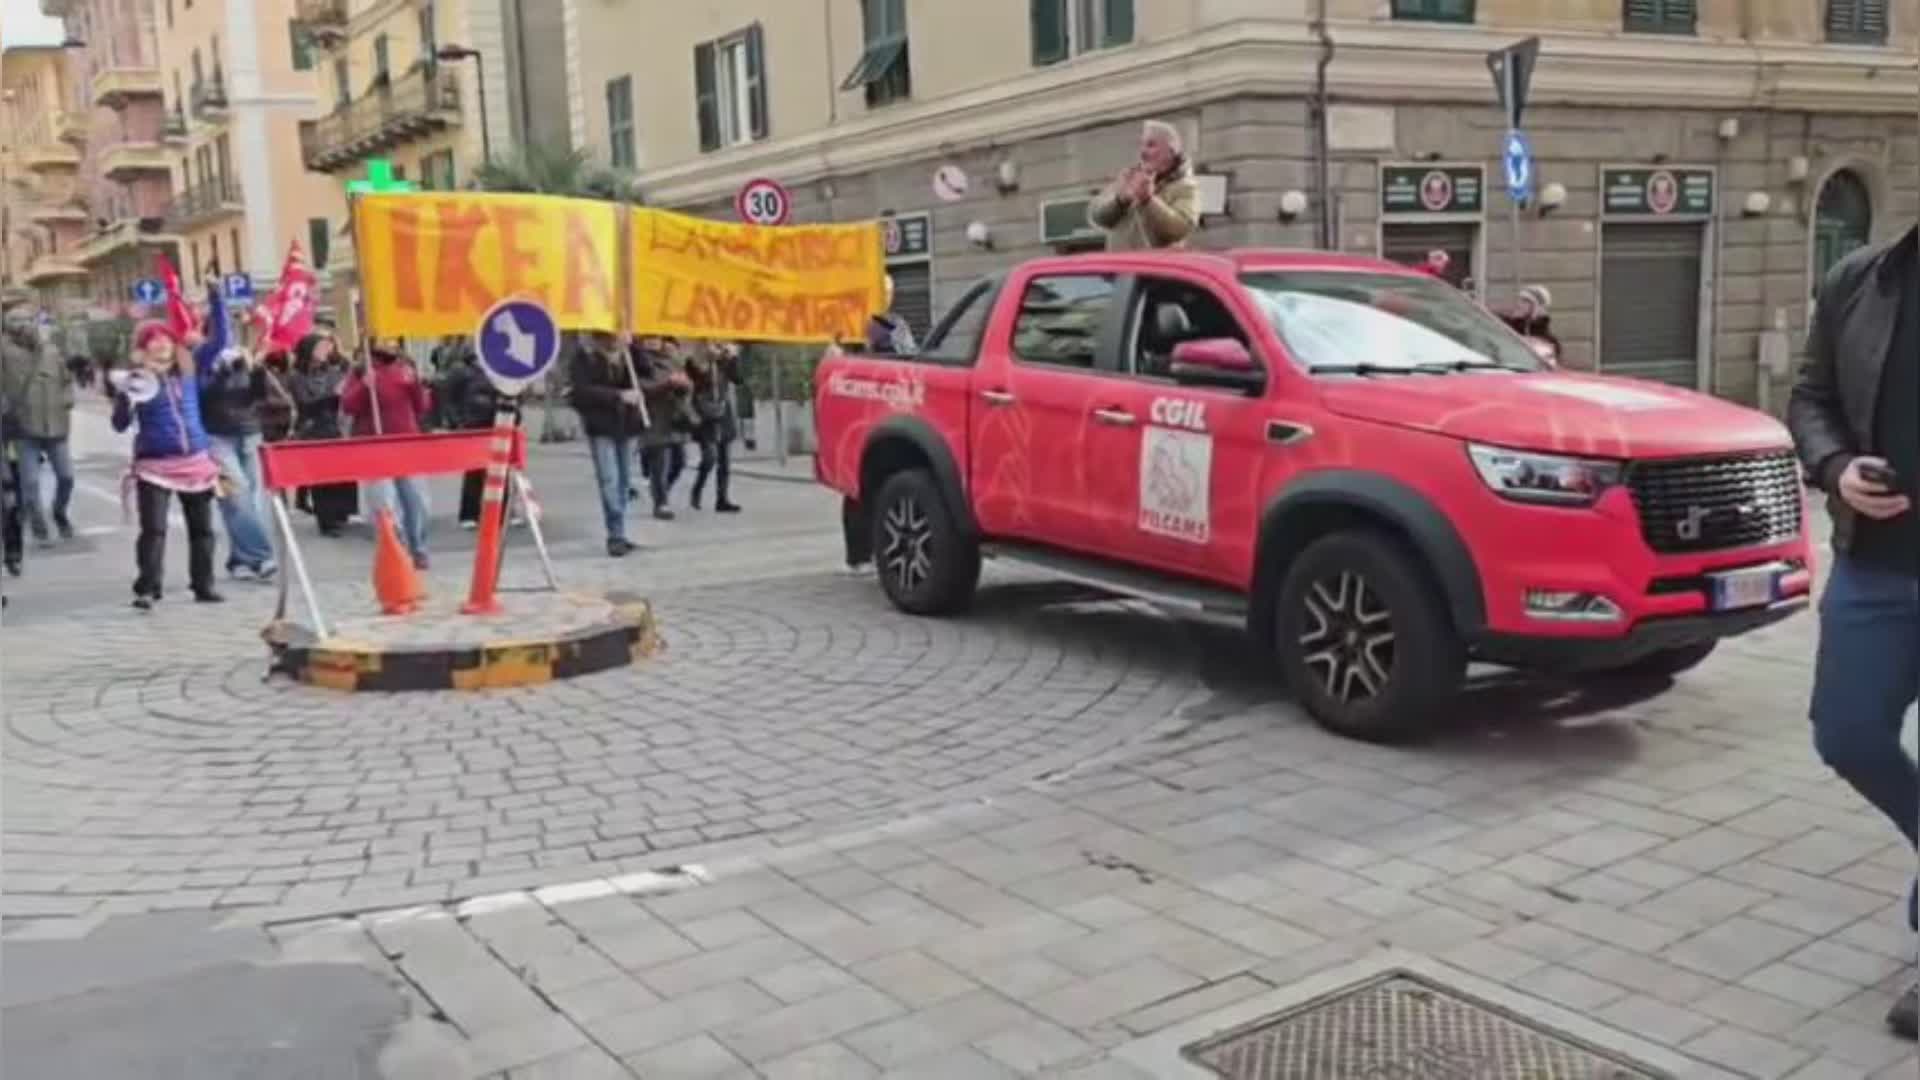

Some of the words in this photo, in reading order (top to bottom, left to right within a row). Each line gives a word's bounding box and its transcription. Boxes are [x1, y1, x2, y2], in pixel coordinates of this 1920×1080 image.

[751, 192, 778, 217] 30
[391, 200, 613, 315] IKEA
[229, 277, 247, 297] P
[1150, 398, 1207, 430] CGIL
